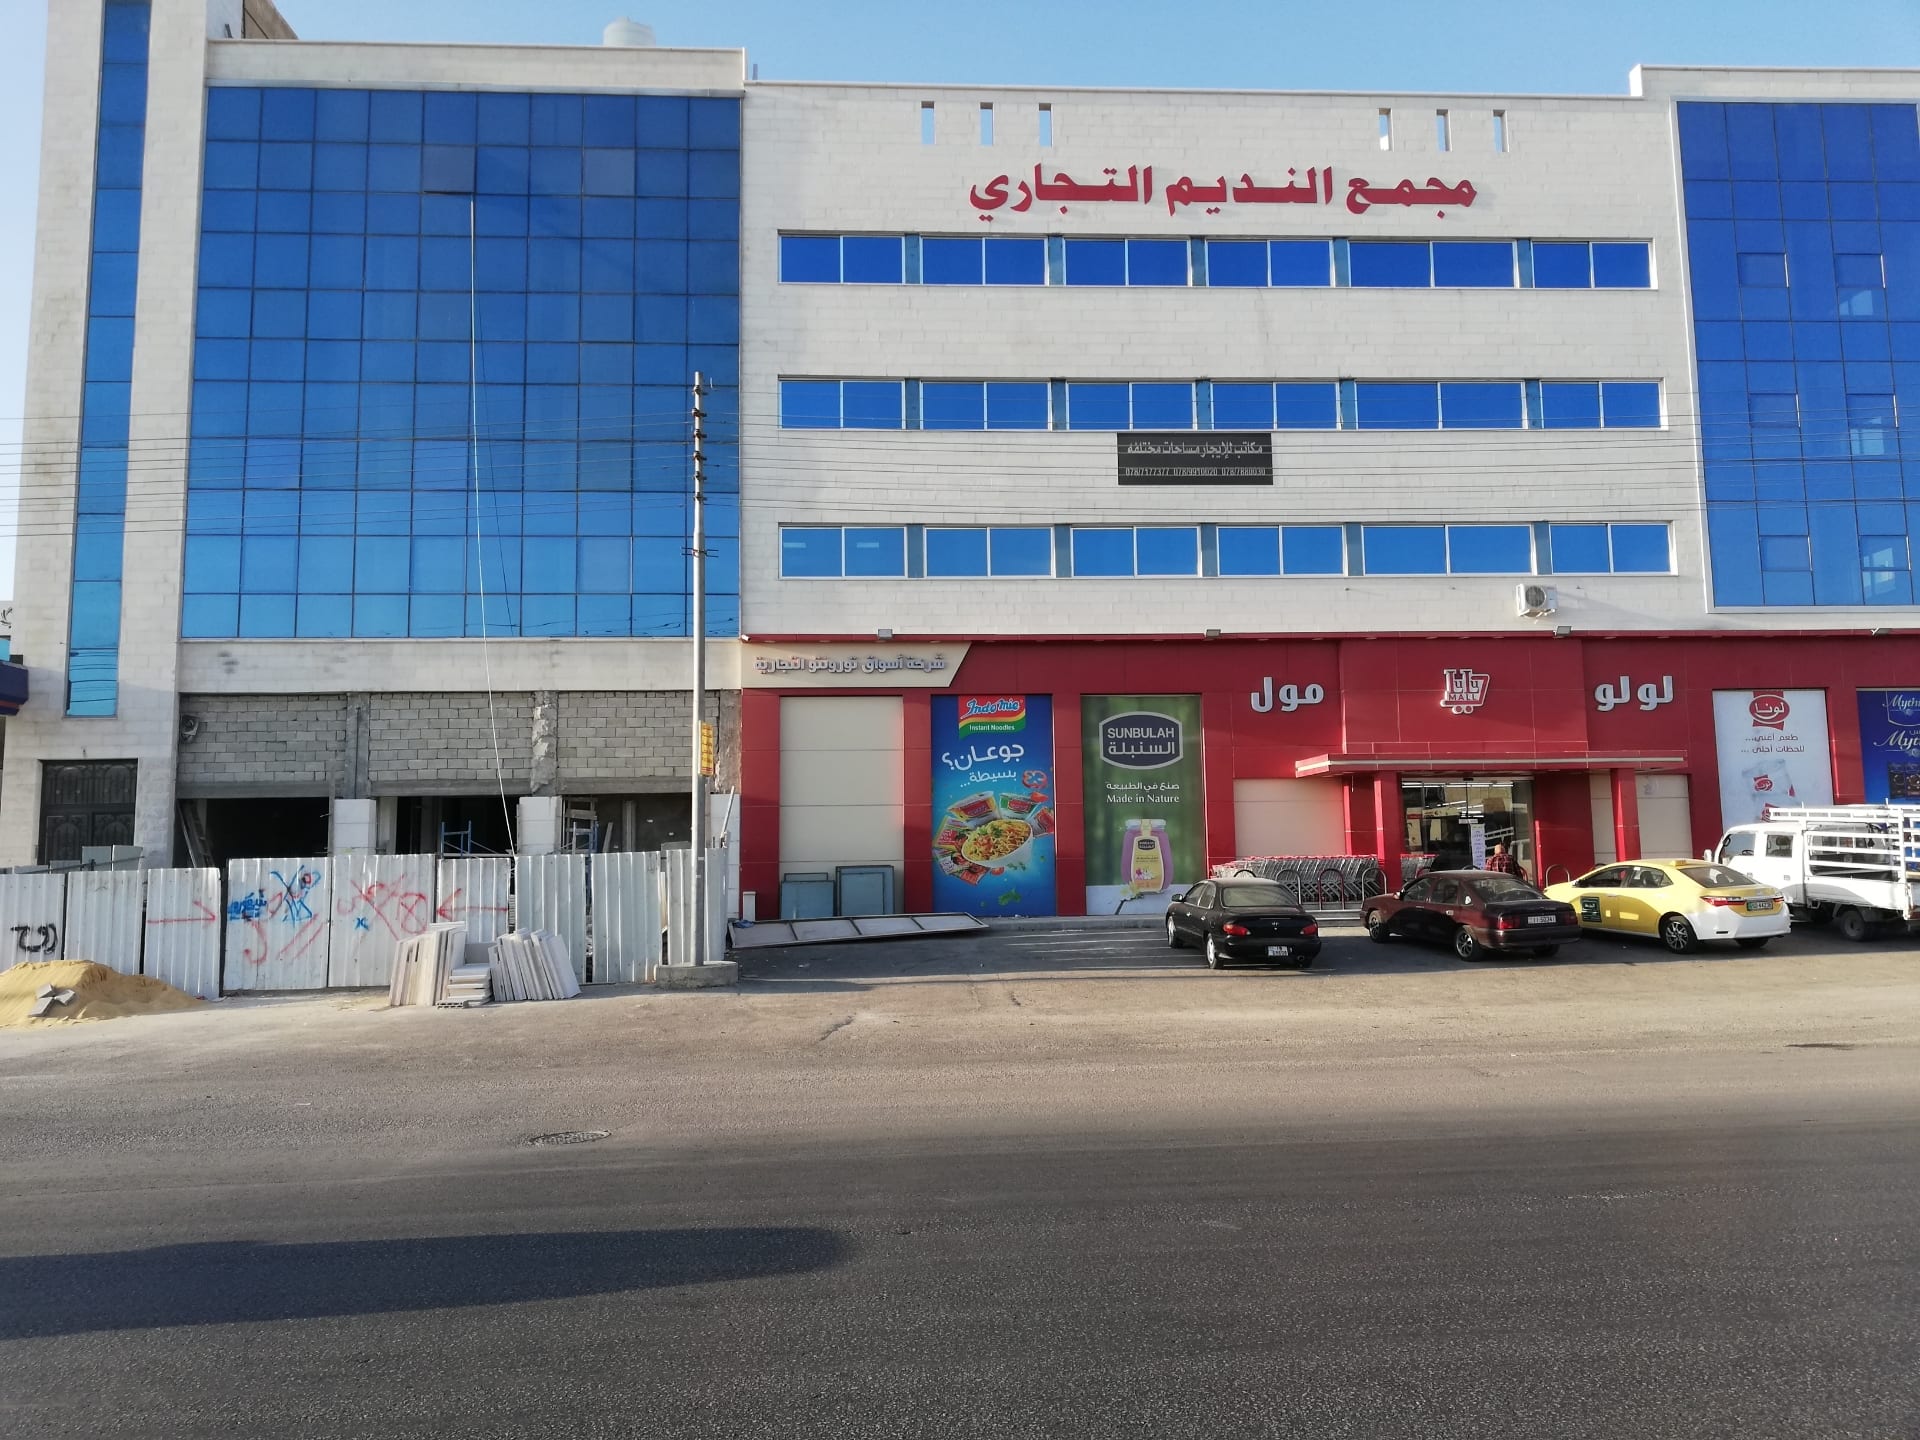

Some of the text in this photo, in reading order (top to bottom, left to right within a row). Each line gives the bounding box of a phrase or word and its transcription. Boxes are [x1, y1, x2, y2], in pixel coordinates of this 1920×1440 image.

[969, 162, 1478, 222] مجمع النديم التجاري
[1234, 440, 1263, 459] مكاتب
[754, 656, 805, 674] التجارية
[862, 655, 903, 674] أسواق
[907, 655, 945, 673] شركة
[1250, 676, 1325, 713] مول
[1449, 693, 1479, 701] MALL
[1594, 675, 1674, 712] لولو
[1754, 701, 1785, 720] لونا
[1107, 727, 1175, 739] SUNBULAH
[1778, 733, 1799, 742] طعم
[1108, 741, 1176, 759] السنبلة
[1159, 781, 1180, 791] صنع
[1106, 794, 1180, 803] Made in Nature
